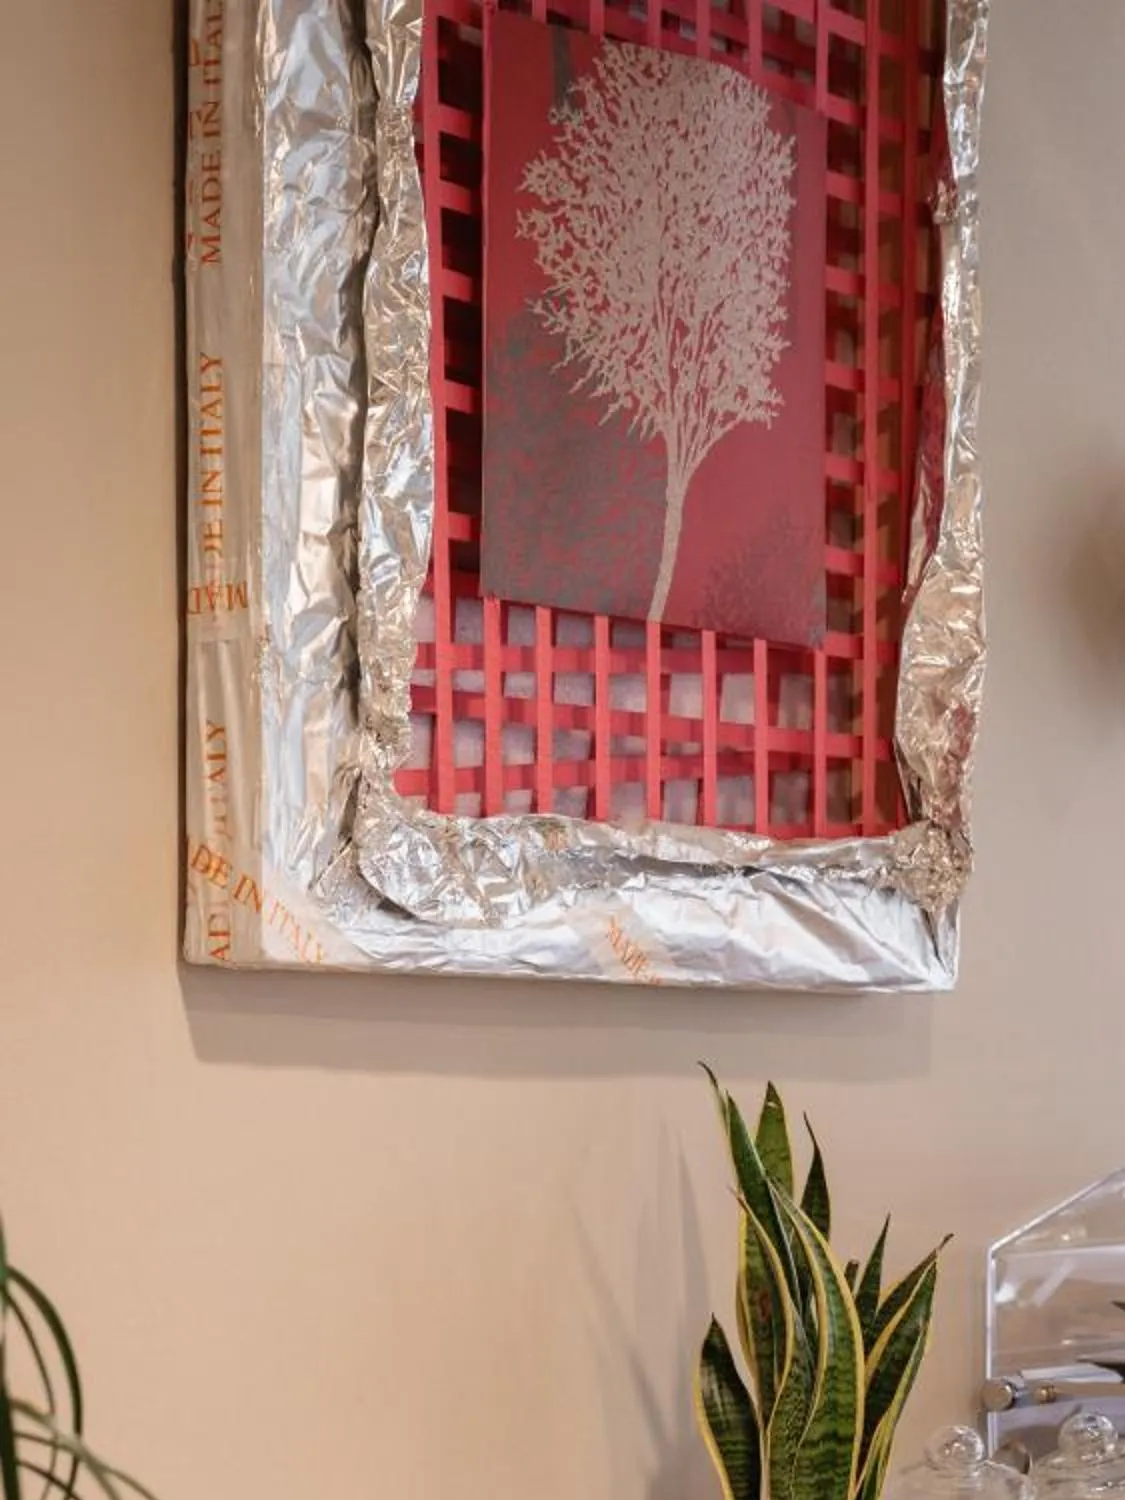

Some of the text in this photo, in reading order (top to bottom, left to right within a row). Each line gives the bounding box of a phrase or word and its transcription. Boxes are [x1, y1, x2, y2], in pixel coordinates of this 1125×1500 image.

[203, 101, 220, 138] IN
[201, 153, 221, 264] MADE
[200, 350, 223, 457] ITALY
[201, 469, 222, 506] IN
